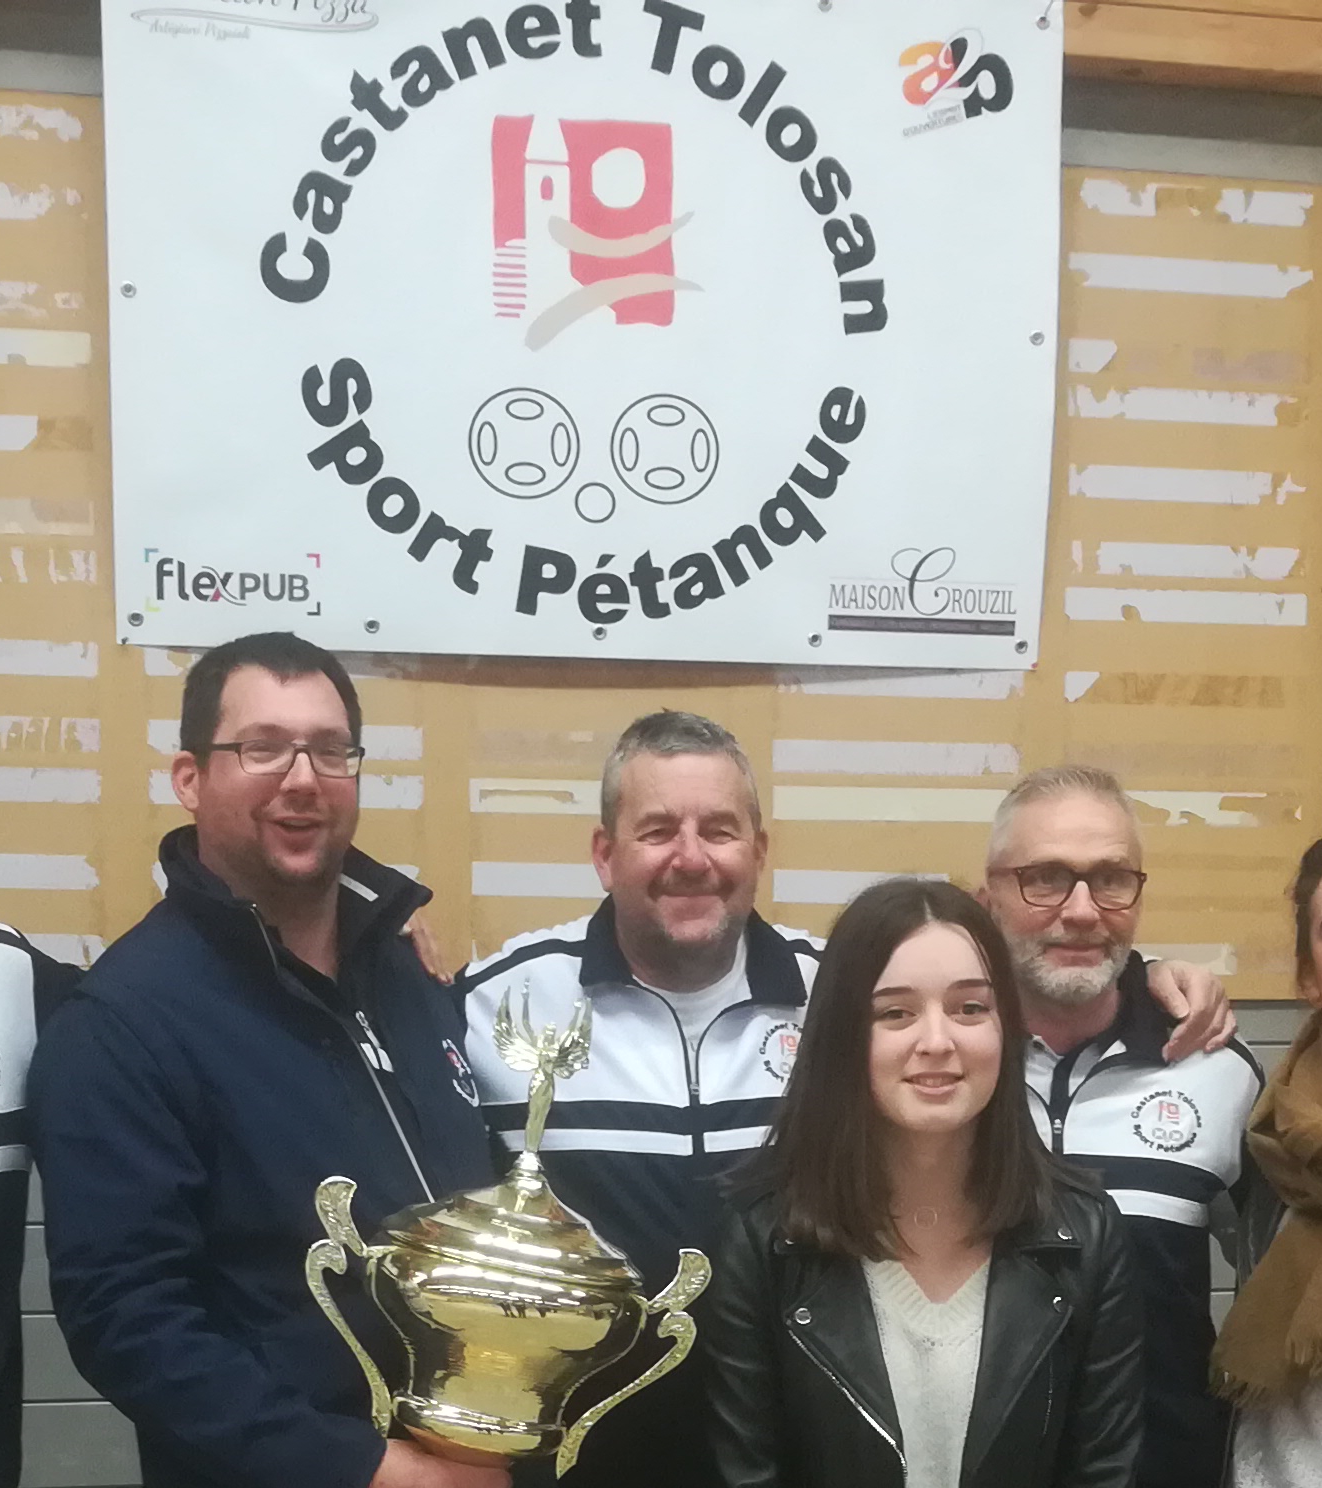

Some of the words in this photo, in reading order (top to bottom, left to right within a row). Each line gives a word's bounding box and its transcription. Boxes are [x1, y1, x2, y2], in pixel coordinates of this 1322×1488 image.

[260, 0, 602, 304] Castanet
[643, 0, 889, 335] Tolosan
[301, 357, 494, 595] Sport
[515, 386, 867, 626] Pétanque
[828, 584, 906, 611] MAISON
[891, 547, 1017, 616] CROUZIL
